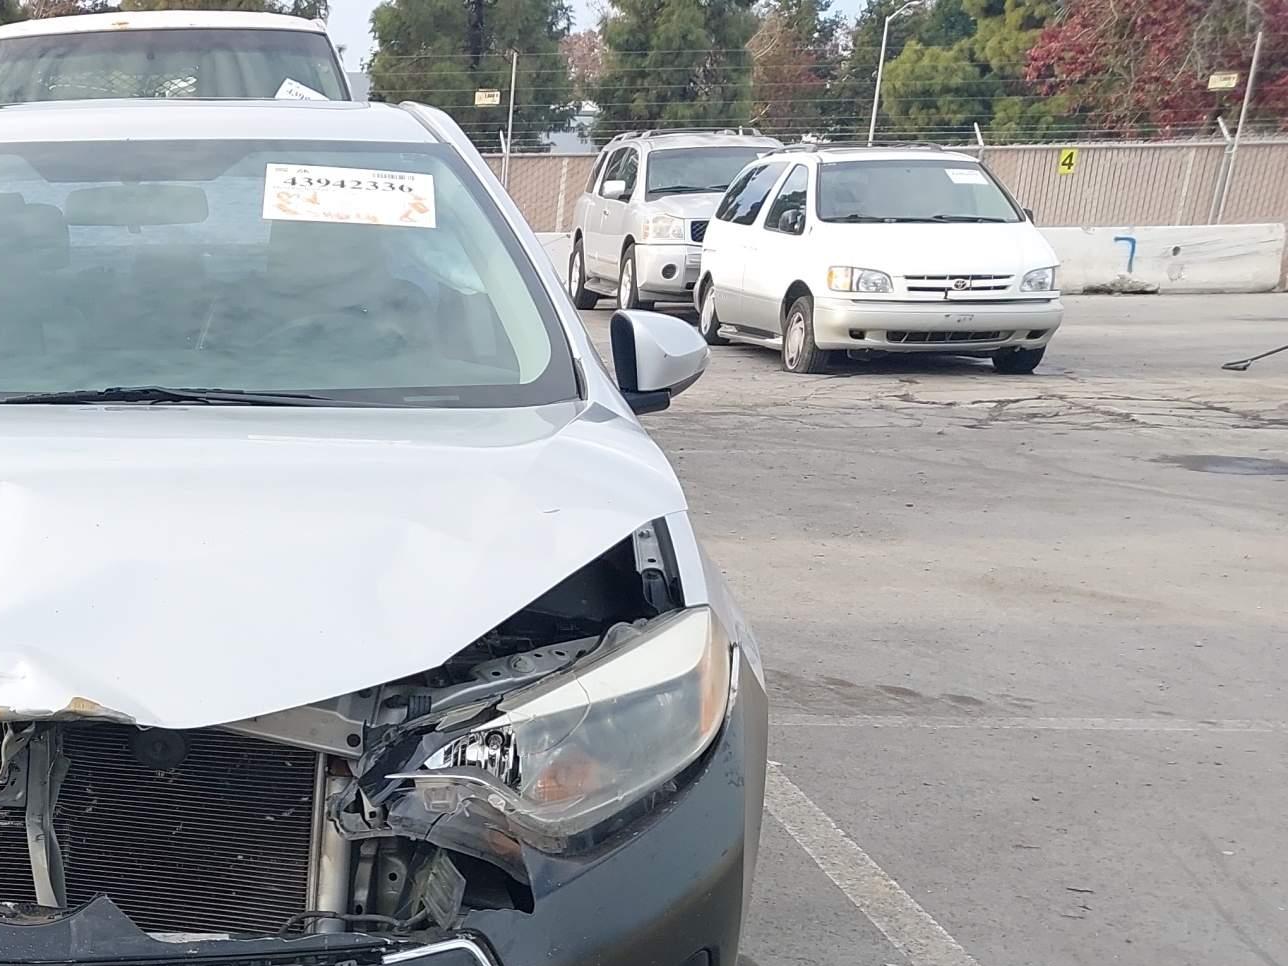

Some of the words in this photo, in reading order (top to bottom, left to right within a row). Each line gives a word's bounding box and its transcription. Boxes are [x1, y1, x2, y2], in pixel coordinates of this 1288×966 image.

[1061, 151, 1074, 170] 4
[282, 176, 414, 193] 43942336
[1113, 236, 1137, 273] 7
